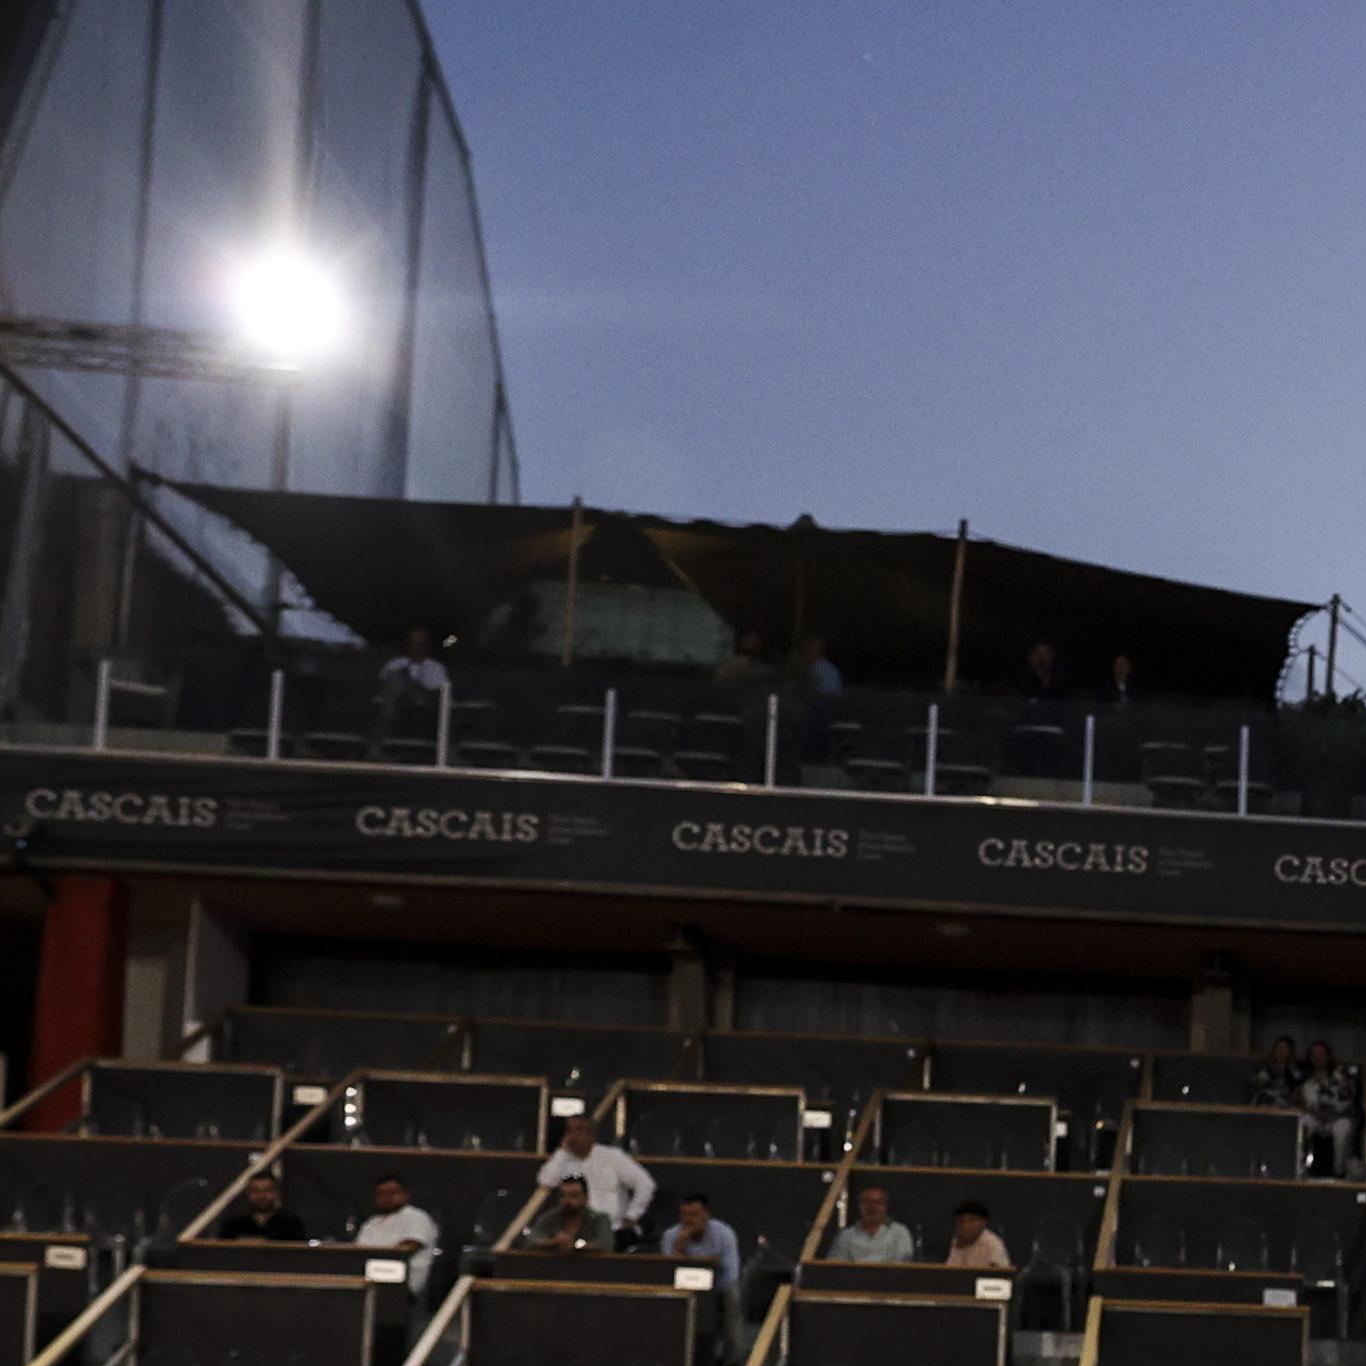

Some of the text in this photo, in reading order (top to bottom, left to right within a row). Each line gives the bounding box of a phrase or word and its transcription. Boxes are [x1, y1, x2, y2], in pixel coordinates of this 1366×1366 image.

[24, 786, 218, 829] CASCAIS
[355, 806, 540, 844] CASCAIS
[671, 821, 850, 859] CASCAIS
[977, 838, 1149, 875] CASCAIS
